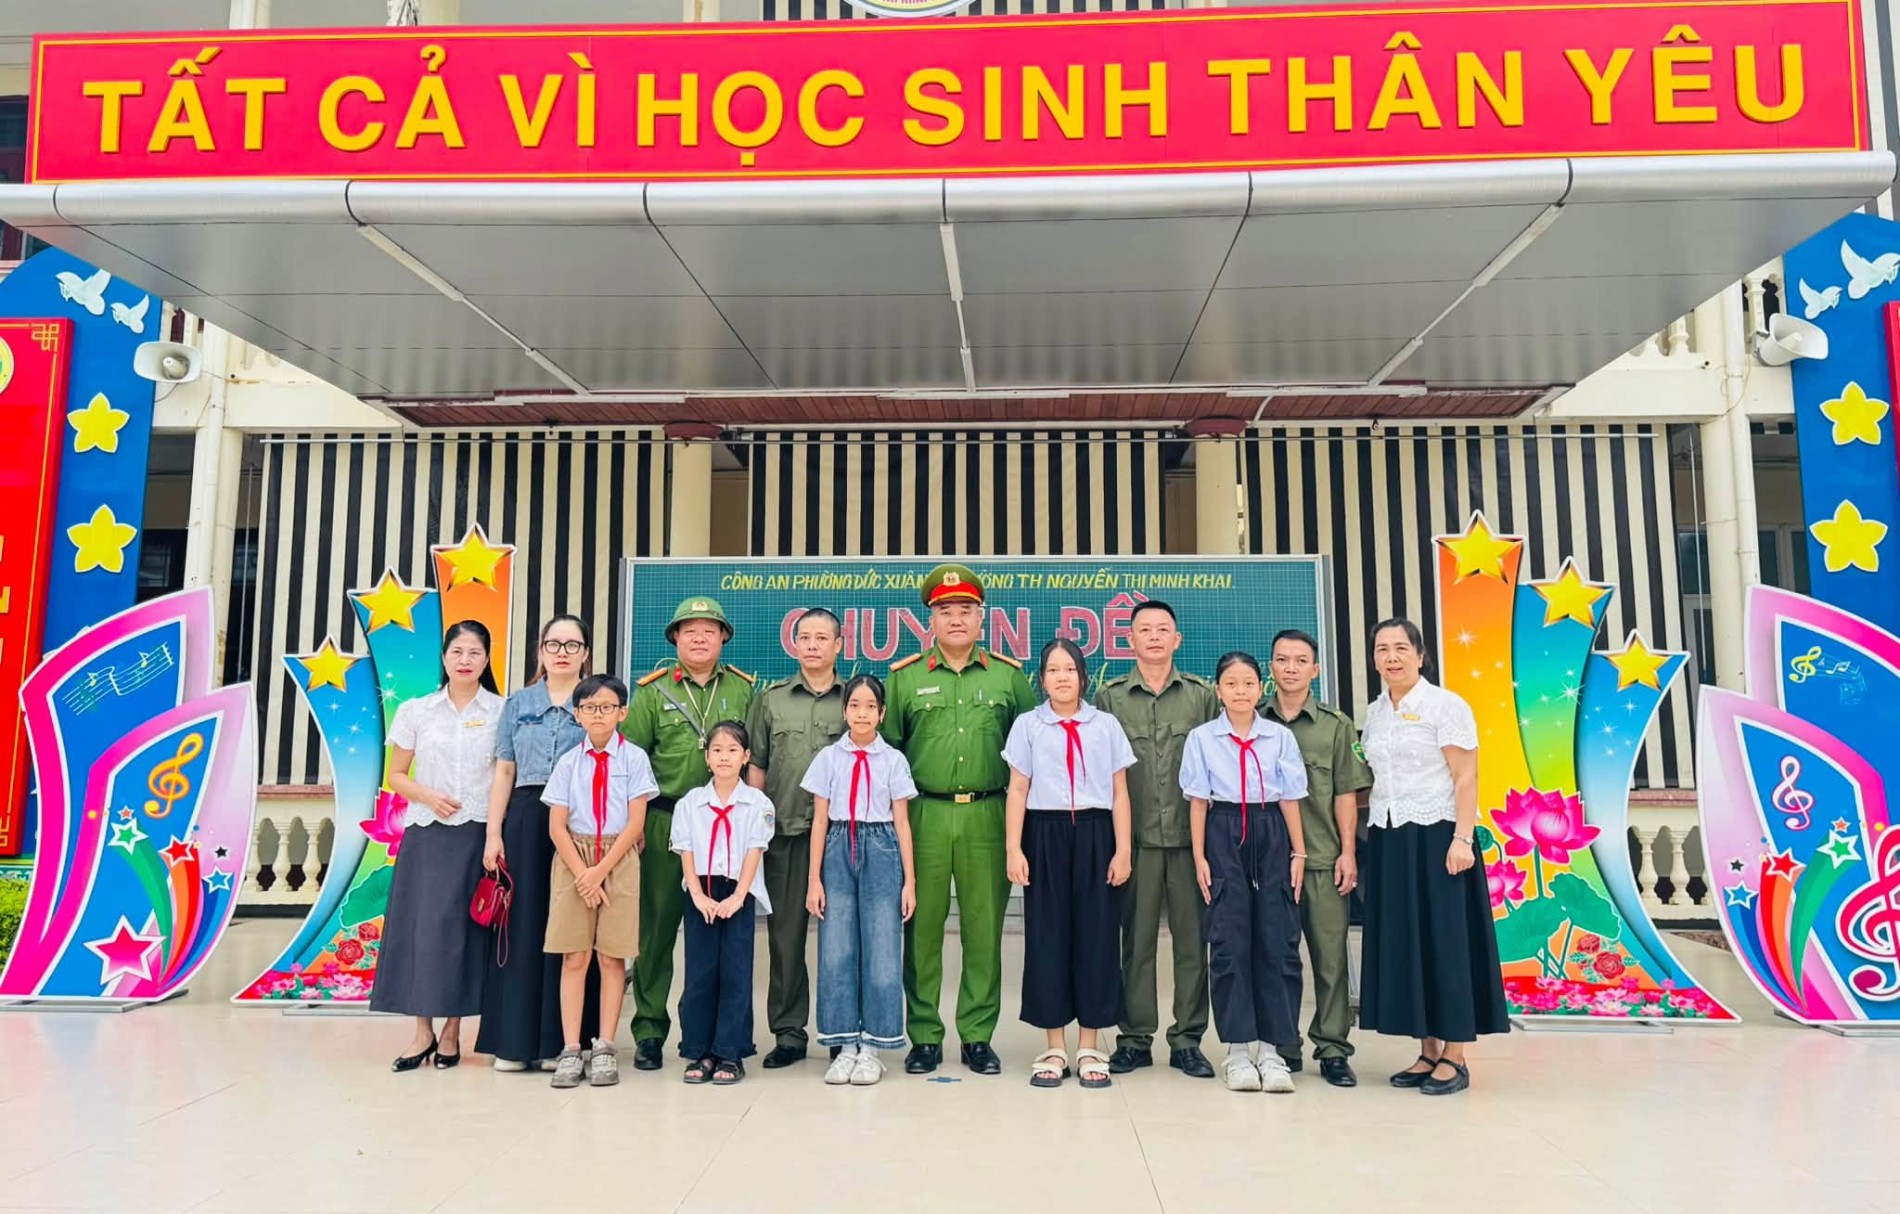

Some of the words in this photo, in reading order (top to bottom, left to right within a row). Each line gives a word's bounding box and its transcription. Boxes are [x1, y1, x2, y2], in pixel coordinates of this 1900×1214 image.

[82, 46, 287, 153] TẤT
[317, 44, 466, 152] CẢ
[498, 52, 597, 147] VÌ
[636, 68, 866, 167] HỌC
[902, 64, 1169, 146] SINH
[1206, 31, 1525, 138] THÂN
[1563, 23, 1806, 126] YÊU
[721, 571, 763, 590] CÔNG
[765, 573, 790, 590] AN
[1017, 573, 1043, 589] TH
[1046, 567, 1119, 589] NGUYỄN
[1122, 573, 1147, 591] THỊ
[1149, 573, 1190, 589] MINH
[780, 604, 1031, 661] CHUYN
